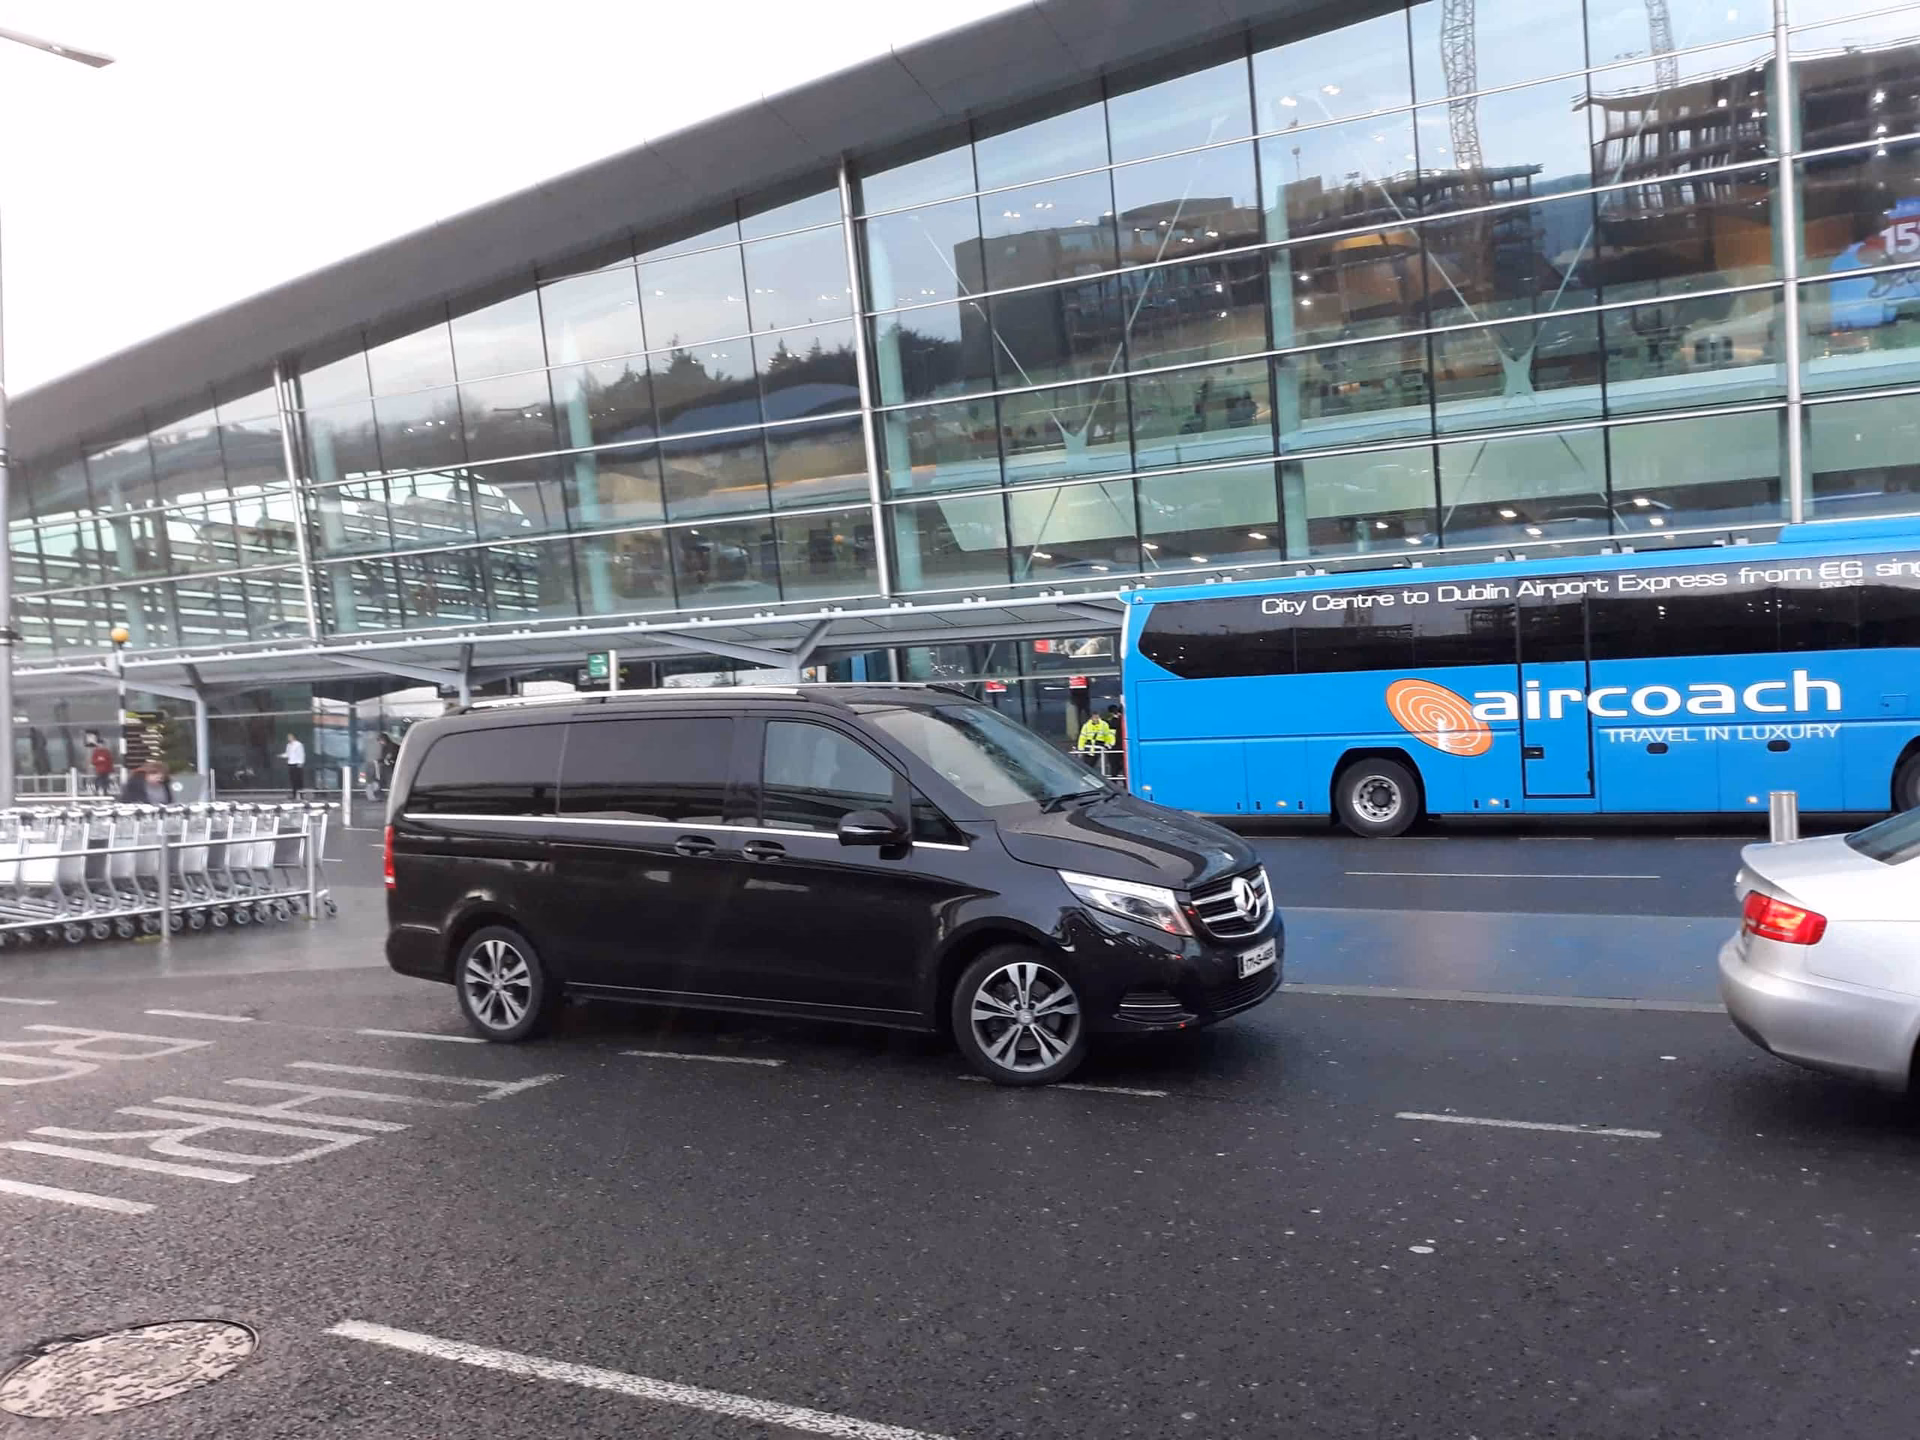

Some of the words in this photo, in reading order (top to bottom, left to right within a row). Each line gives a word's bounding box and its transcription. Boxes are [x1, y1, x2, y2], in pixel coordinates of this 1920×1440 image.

[1261, 597, 1307, 616] City
[1312, 593, 1395, 611] Centre
[1402, 590, 1429, 605] to
[1437, 583, 1510, 603] Dublin
[1516, 578, 1609, 600] Airport
[1618, 573, 1728, 593] Express
[1738, 567, 1812, 585] from
[1818, 560, 1864, 580] €6
[1471, 669, 1842, 721] aircoach
[1608, 727, 1698, 744] TRAVEL
[1705, 726, 1730, 741] IN
[1738, 723, 1841, 741] LUXURY
